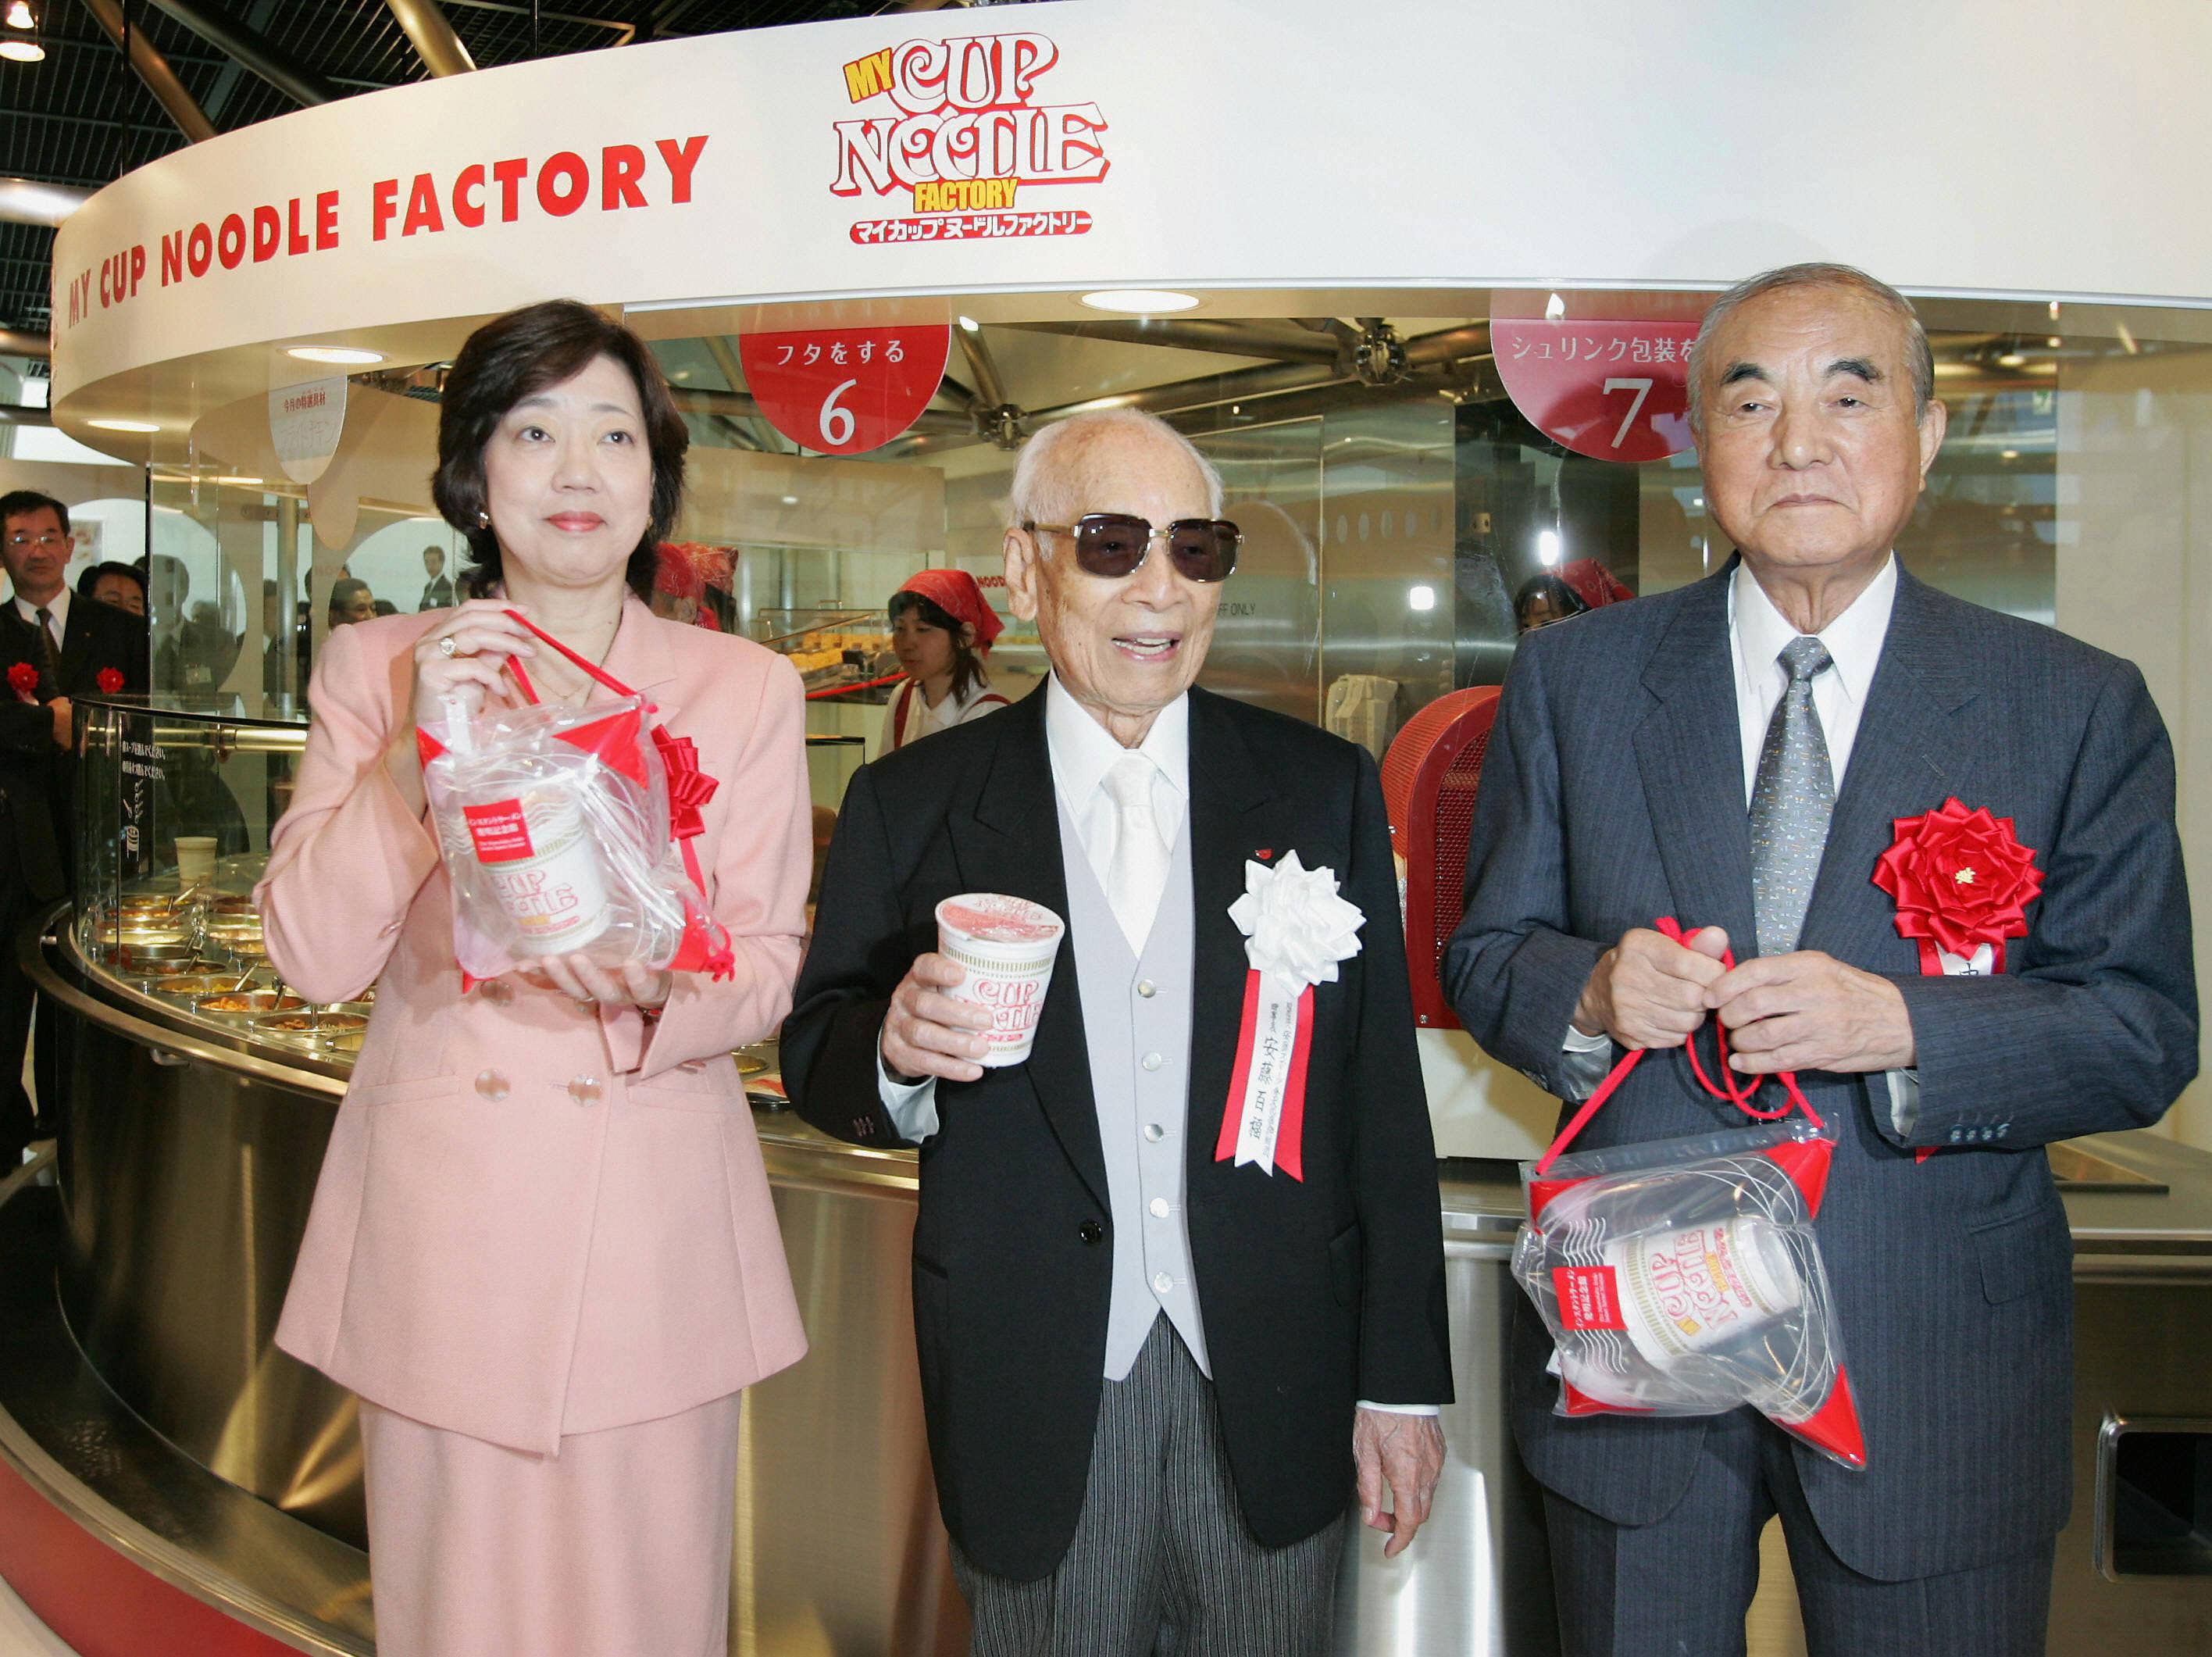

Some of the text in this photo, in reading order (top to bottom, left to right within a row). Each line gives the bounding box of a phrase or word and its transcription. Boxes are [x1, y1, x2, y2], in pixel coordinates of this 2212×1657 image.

[844, 48, 894, 103] MY
[889, 33, 1059, 117] CUP
[830, 102, 1111, 197] NOODLE
[912, 177, 1019, 213] FACTORY
[69, 268, 91, 329] MY
[101, 245, 147, 309] CUP
[162, 191, 339, 287] NOODLE
[373, 136, 708, 241] FACTORY
[855, 211, 1093, 244] マイカップヌードルファクトリー
[776, 340, 904, 366] フタをする
[819, 378, 857, 446] 6
[1603, 377, 1654, 449] 7
[972, 978, 1040, 1008] CUP
